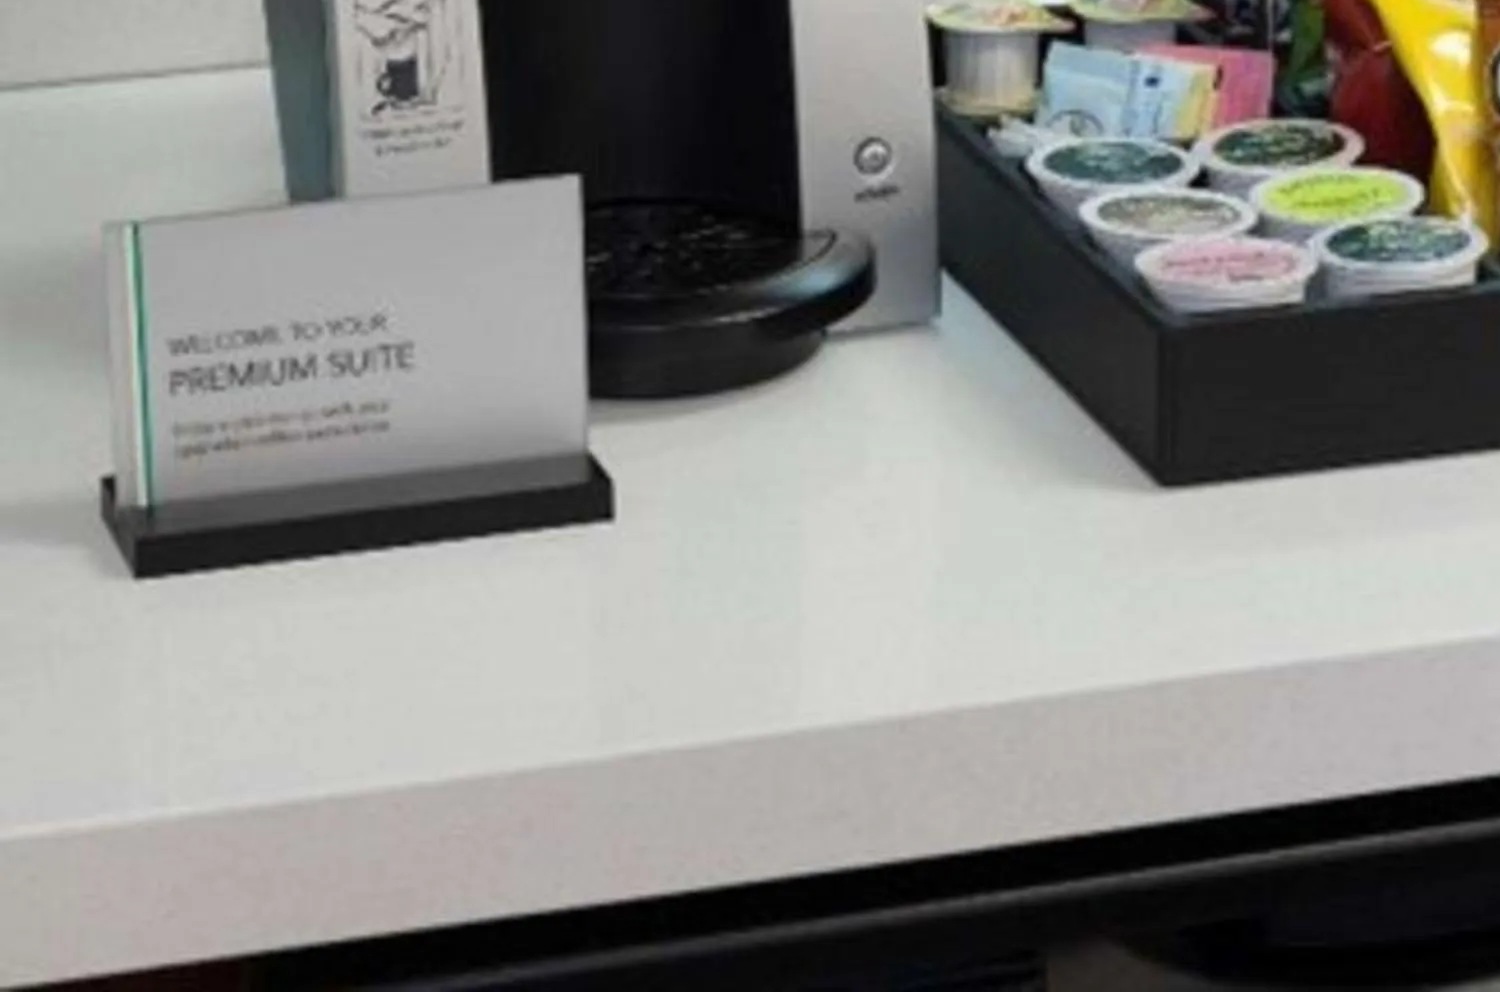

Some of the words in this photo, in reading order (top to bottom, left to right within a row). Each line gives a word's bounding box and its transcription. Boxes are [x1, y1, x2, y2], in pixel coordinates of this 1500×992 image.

[167, 324, 284, 357] WELCOME
[289, 319, 323, 342] TO
[325, 312, 388, 337] YOUR
[168, 352, 319, 397] PREMIUM
[327, 339, 416, 379] SUITE
